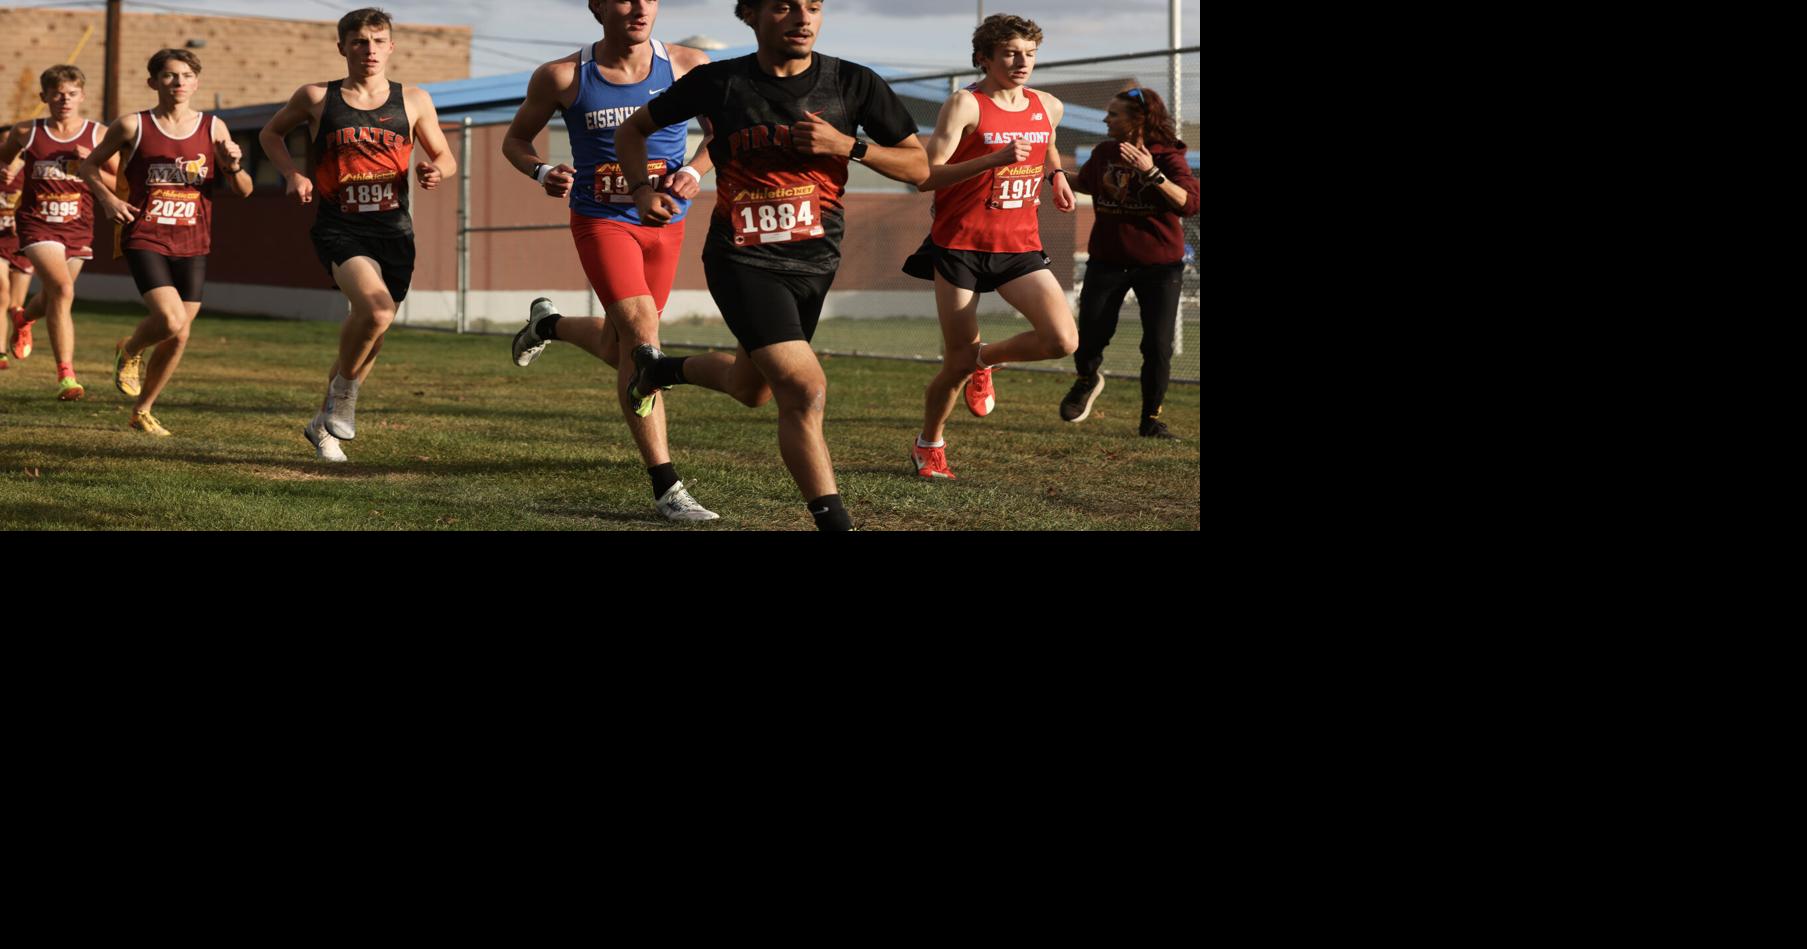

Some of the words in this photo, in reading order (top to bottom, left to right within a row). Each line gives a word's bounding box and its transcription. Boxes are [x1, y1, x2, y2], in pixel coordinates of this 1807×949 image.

[585, 106, 641, 130] EISENH
[984, 131, 1049, 144] EASTMONT
[346, 183, 394, 204] 1894
[602, 174, 660, 194] 190
[999, 177, 1041, 199] 1917
[40, 201, 78, 216] 1995
[151, 199, 196, 217] 2020
[741, 201, 814, 233] 1884
